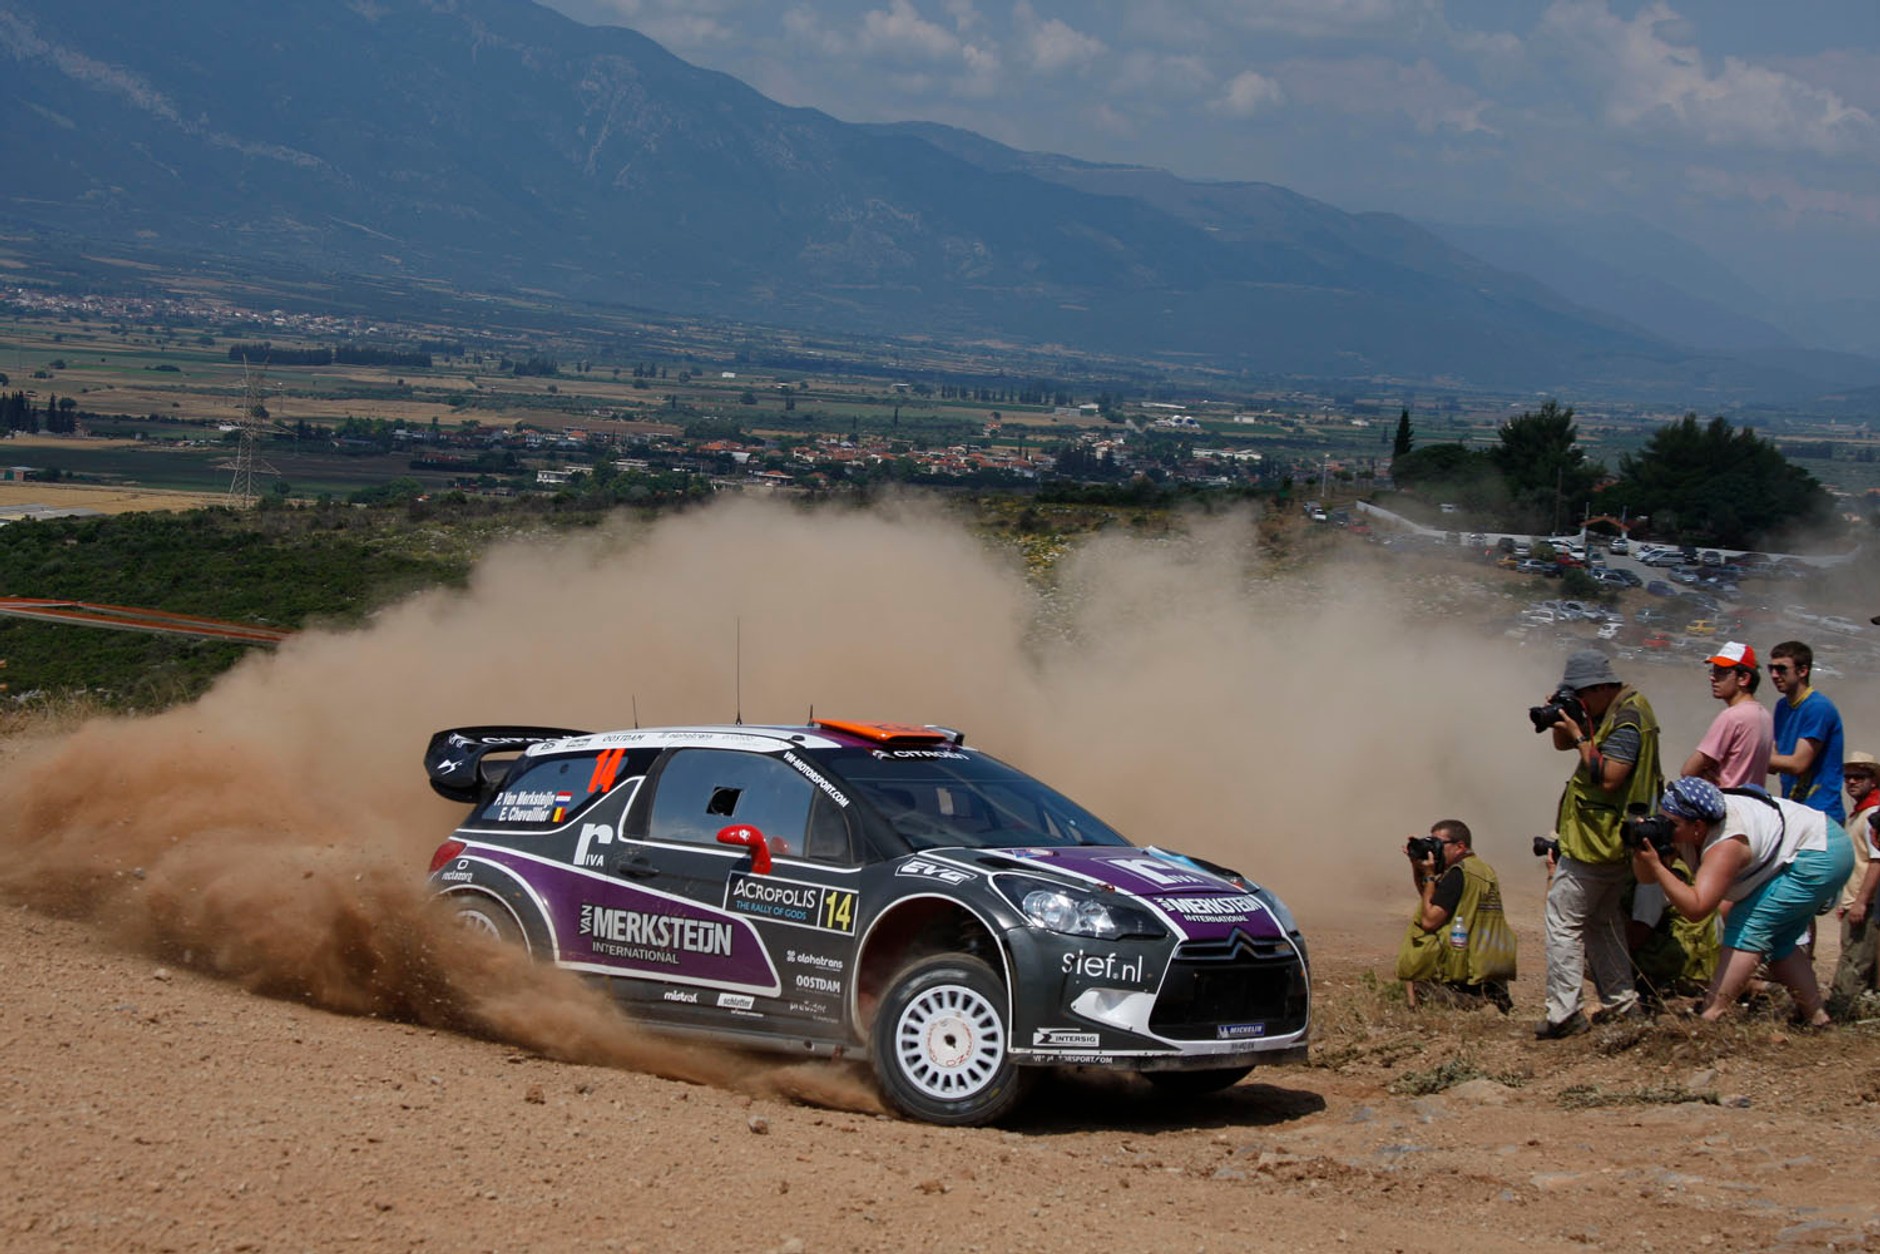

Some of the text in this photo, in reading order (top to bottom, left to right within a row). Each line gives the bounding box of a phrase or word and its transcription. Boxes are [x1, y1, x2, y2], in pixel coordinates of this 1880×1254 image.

[602, 733, 645, 742] OOSTDAM
[893, 748, 970, 761] CITROËN
[587, 748, 627, 793] 14
[783, 751, 850, 808] VM-MOTORSPORT.COM
[494, 792, 503, 806] P.
[503, 791, 517, 806] Van
[498, 806, 508, 822] E.
[733, 878, 816, 909] ACROPOLIS
[736, 900, 807, 920] THE RALLY OF GODS
[826, 891, 853, 931] 14
[1183, 914, 1249, 923] INTERNATIONAL
[579, 904, 733, 956] VAN MERKSTEIJN
[592, 941, 680, 965] INTERNATIONAL
[797, 953, 843, 969] alphatrans
[1061, 949, 1143, 983] sief.nl
[796, 975, 841, 993] OOSTDAM
[664, 990, 698, 1003] mistral
